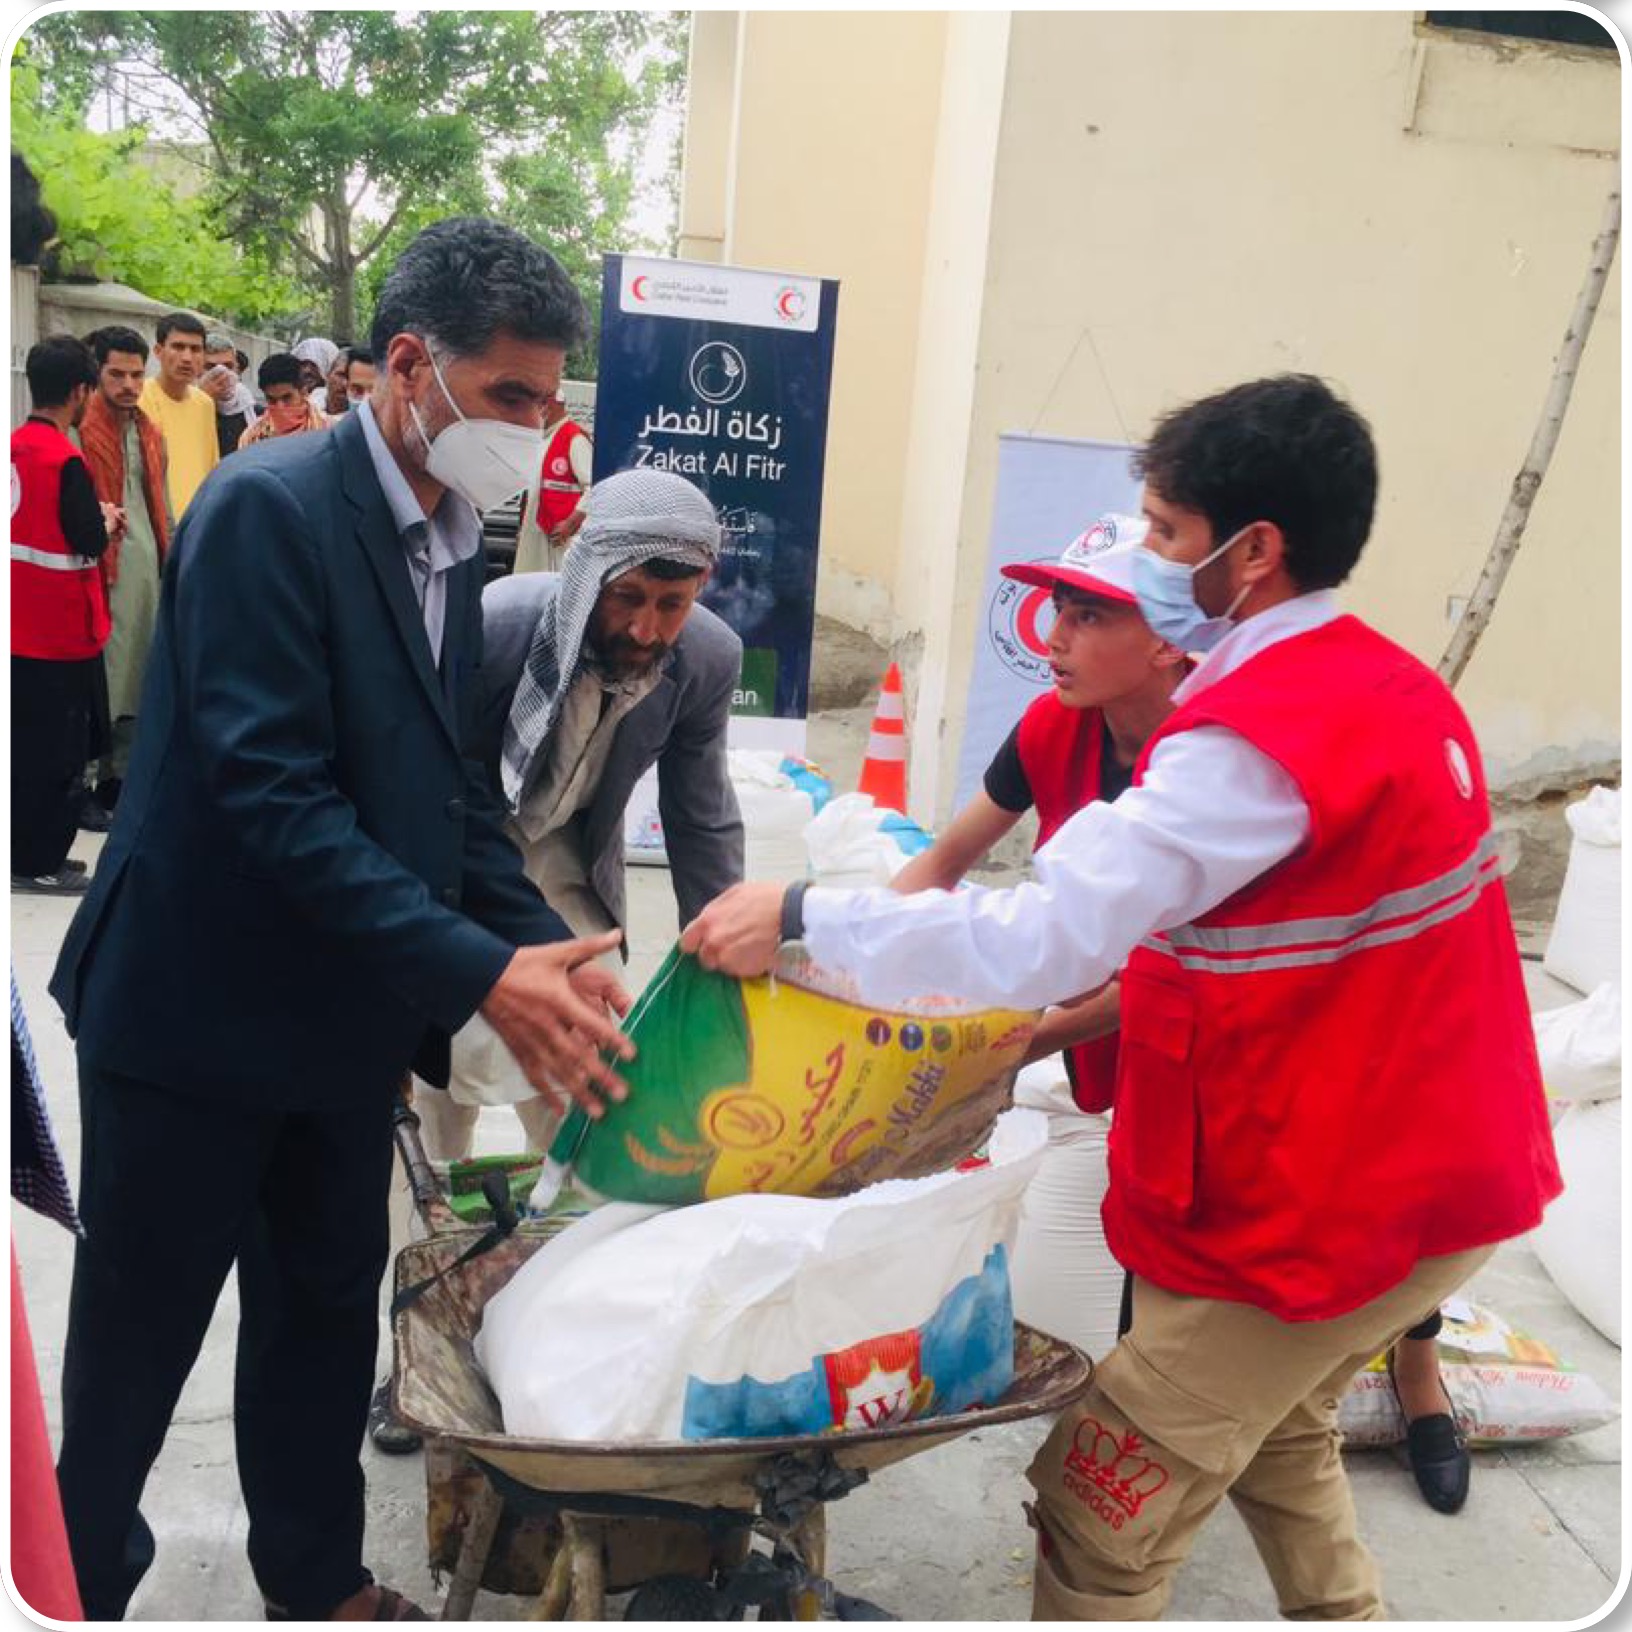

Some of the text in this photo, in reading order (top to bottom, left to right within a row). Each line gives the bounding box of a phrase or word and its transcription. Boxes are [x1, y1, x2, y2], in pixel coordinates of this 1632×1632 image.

[638, 405, 782, 450] زكاة الفطر
[635, 445, 786, 482] Zakat Al Fitr
[857, 1389, 909, 1428] W
[1061, 1471, 1127, 1533] adidas
